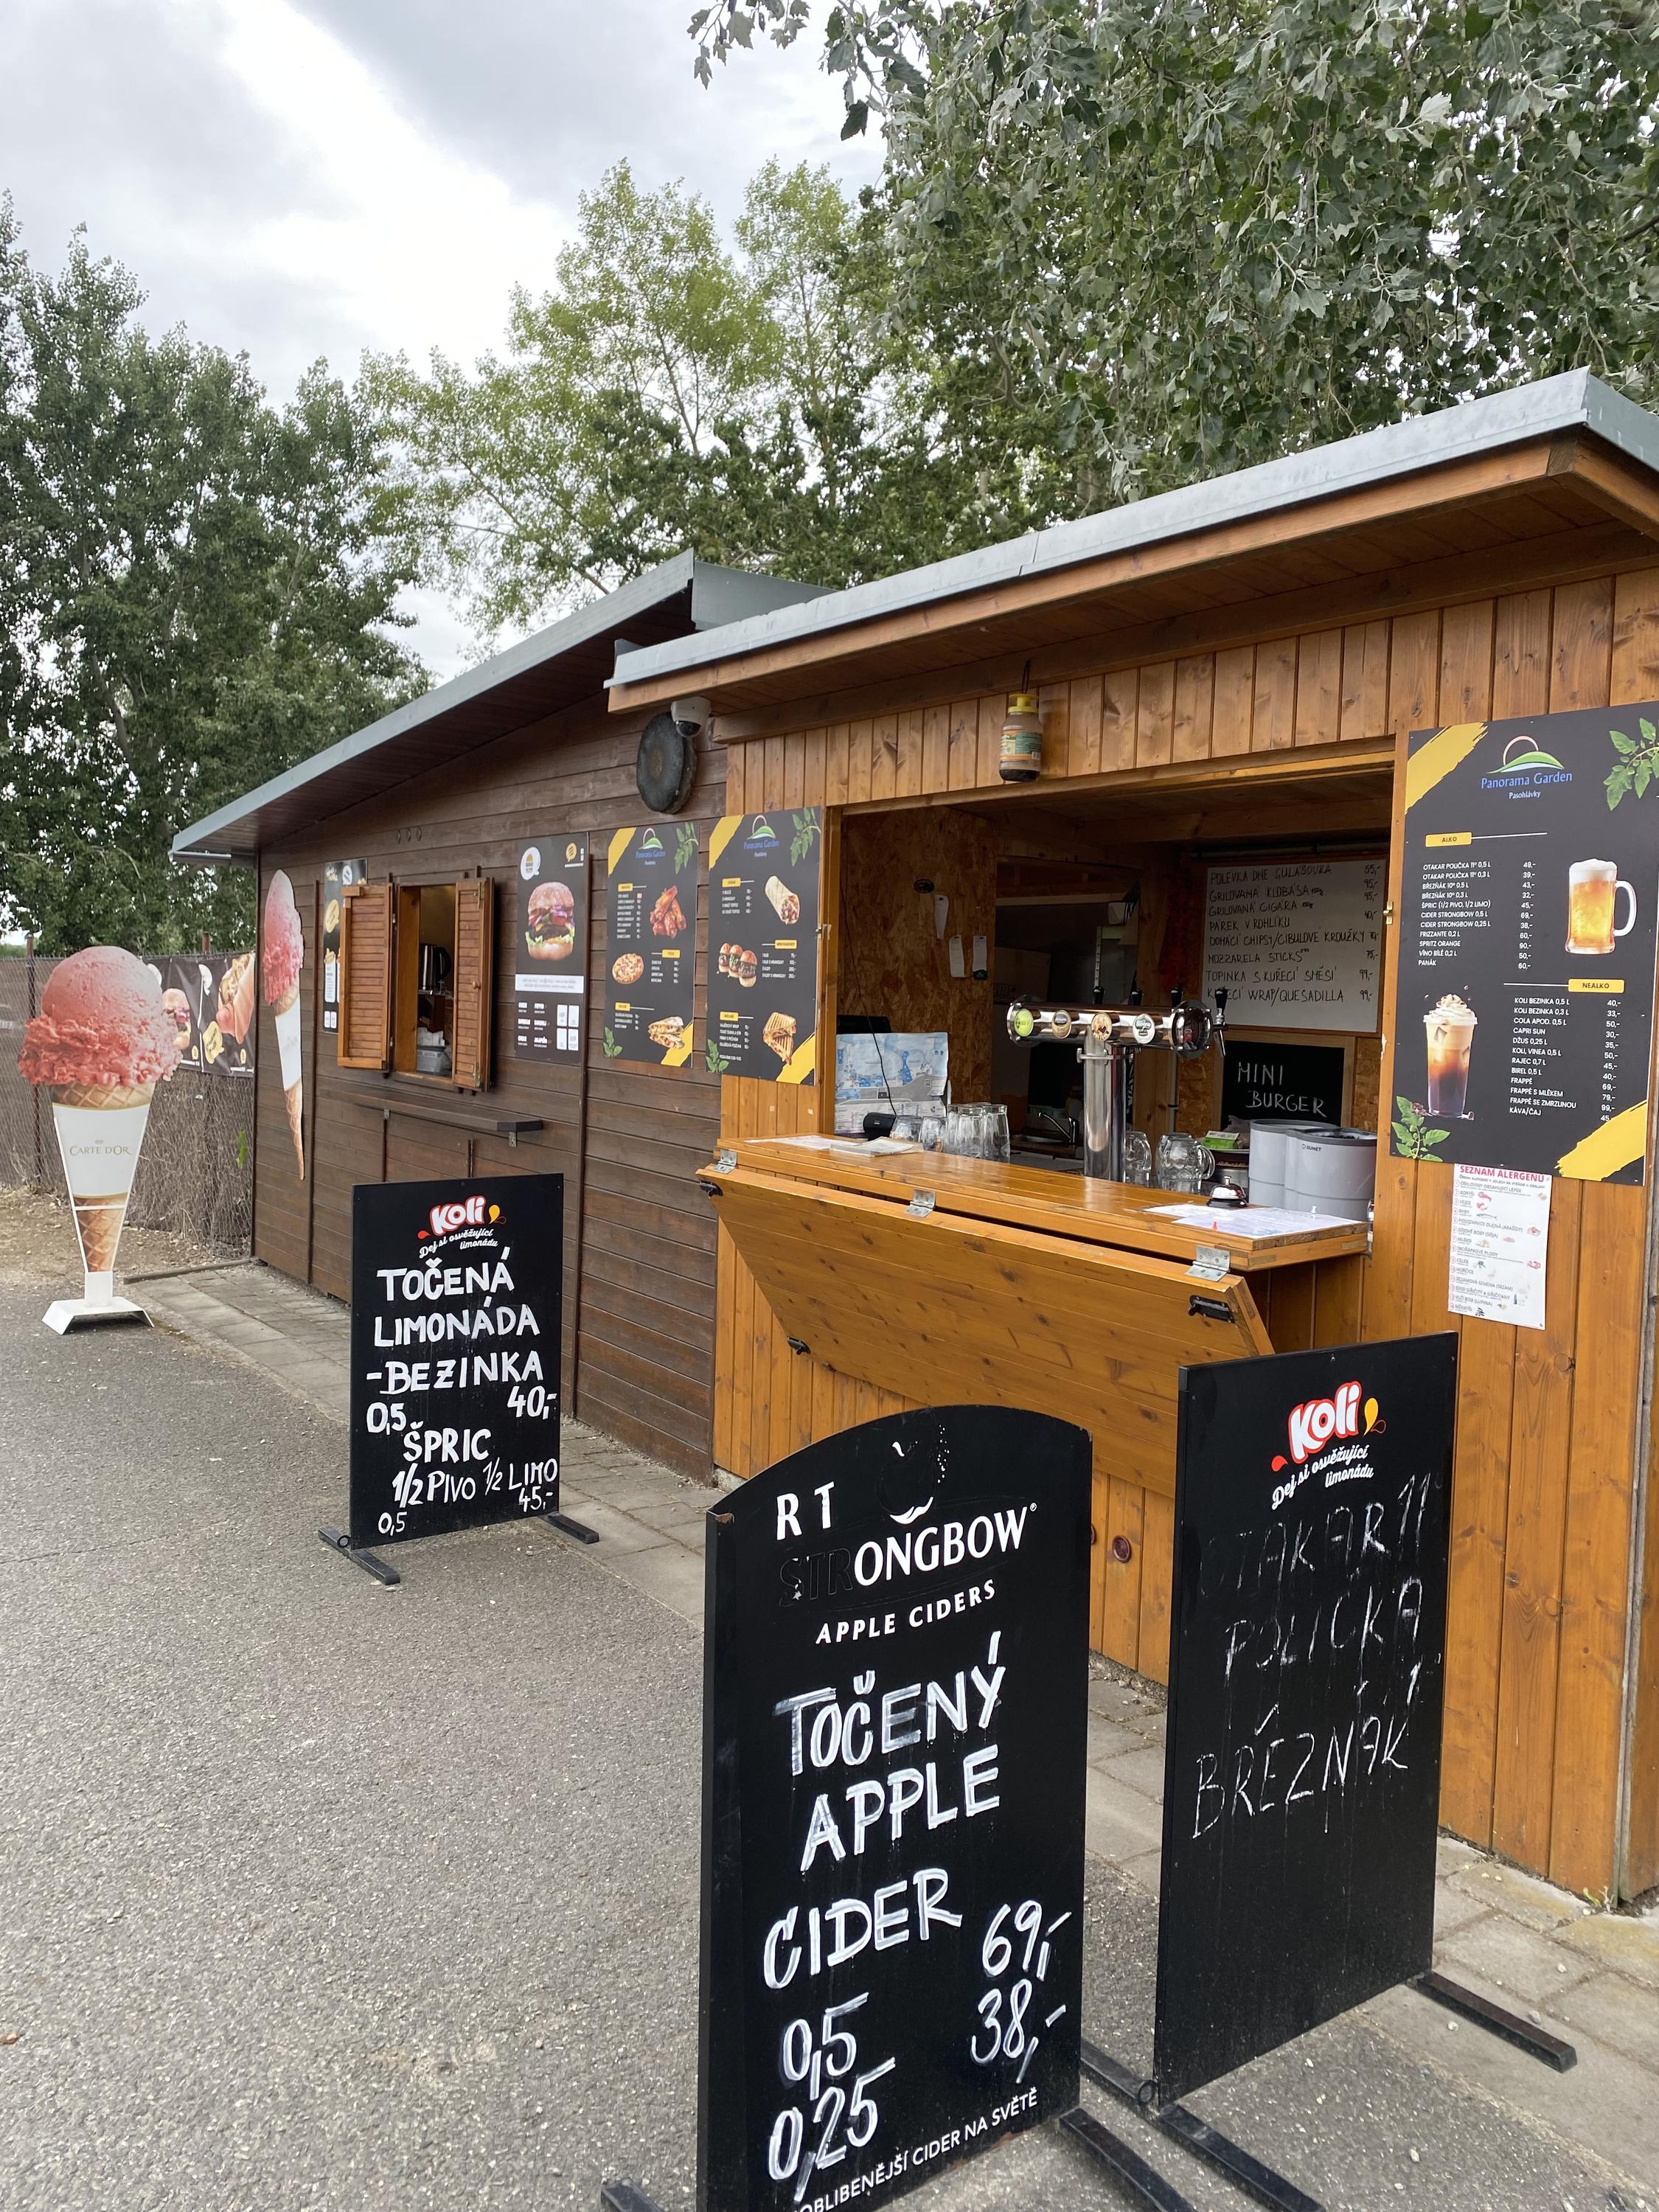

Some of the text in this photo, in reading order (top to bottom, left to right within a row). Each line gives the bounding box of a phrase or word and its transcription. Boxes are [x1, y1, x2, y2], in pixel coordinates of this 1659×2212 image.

[1481, 772, 1573, 789] Panorama Garden
[1509, 790, 1541, 799] Pasohlávky
[1438, 900, 1448, 908] (1/2
[1465, 900, 1473, 908] 1/2
[1474, 900, 1490, 908] LIMO)
[1208, 953, 1260, 964] MOZZARELA
[1268, 950, 1304, 963] STICKS
[1206, 970, 1247, 982] TOPINKA
[1359, 969, 1374, 981] 99,-
[1359, 990, 1373, 1002] 99,-
[1607, 1009, 1620, 1018] 33,-
[1604, 1041, 1618, 1049] 35,-
[1604, 1051, 1618, 1060] 50,-
[1238, 1061, 1284, 1086] MINI
[1245, 1090, 1327, 1118] BURGER
[1538, 1088, 1562, 1096] MLÉKEM
[1602, 1093, 1615, 1102] 79,-
[1541, 1099, 1576, 1108] ZMRZLINOU
[1601, 1104, 1615, 1112] 99,-
[1509, 1107, 1541, 1116] KÁVA/ČAJ
[69, 1145, 101, 1156] CARTE
[1460, 1165, 1544, 1183] SEZNAM ALERGENU
[430, 1195, 486, 1236] Koli
[419, 1228, 494, 1259] Dej si osvěžující
[459, 1239, 498, 1251] limonádu
[377, 1246, 515, 1302] TOČENÁ
[373, 1295, 540, 1347] LIMONÁDA
[366, 1386, 557, 1436] 0,5 40,-
[1288, 1380, 1363, 1464] Koli
[403, 1420, 492, 1464] ŠPRIC
[392, 1456, 558, 1509] 1/2 PIVO 1/2 LIMO
[1271, 1444, 1370, 1510] Dej si osvěžující
[1324, 1463, 1374, 1488] limonádu
[377, 1511, 408, 1537] 0,5
[815, 1579, 995, 1644] APPLE CIDERS
[772, 1630, 1006, 1776] TOČENÝ
[801, 1745, 1001, 1873] APPLE
[764, 1868, 963, 1989] CIDER
[783, 1992, 869, 2101] 0,5
[768, 2058, 896, 2202] 0,25
[912, 2129, 961, 2167] CIDER
[964, 2115, 989, 2141] NA
[992, 2087, 1039, 2126] SVĚTĚ
